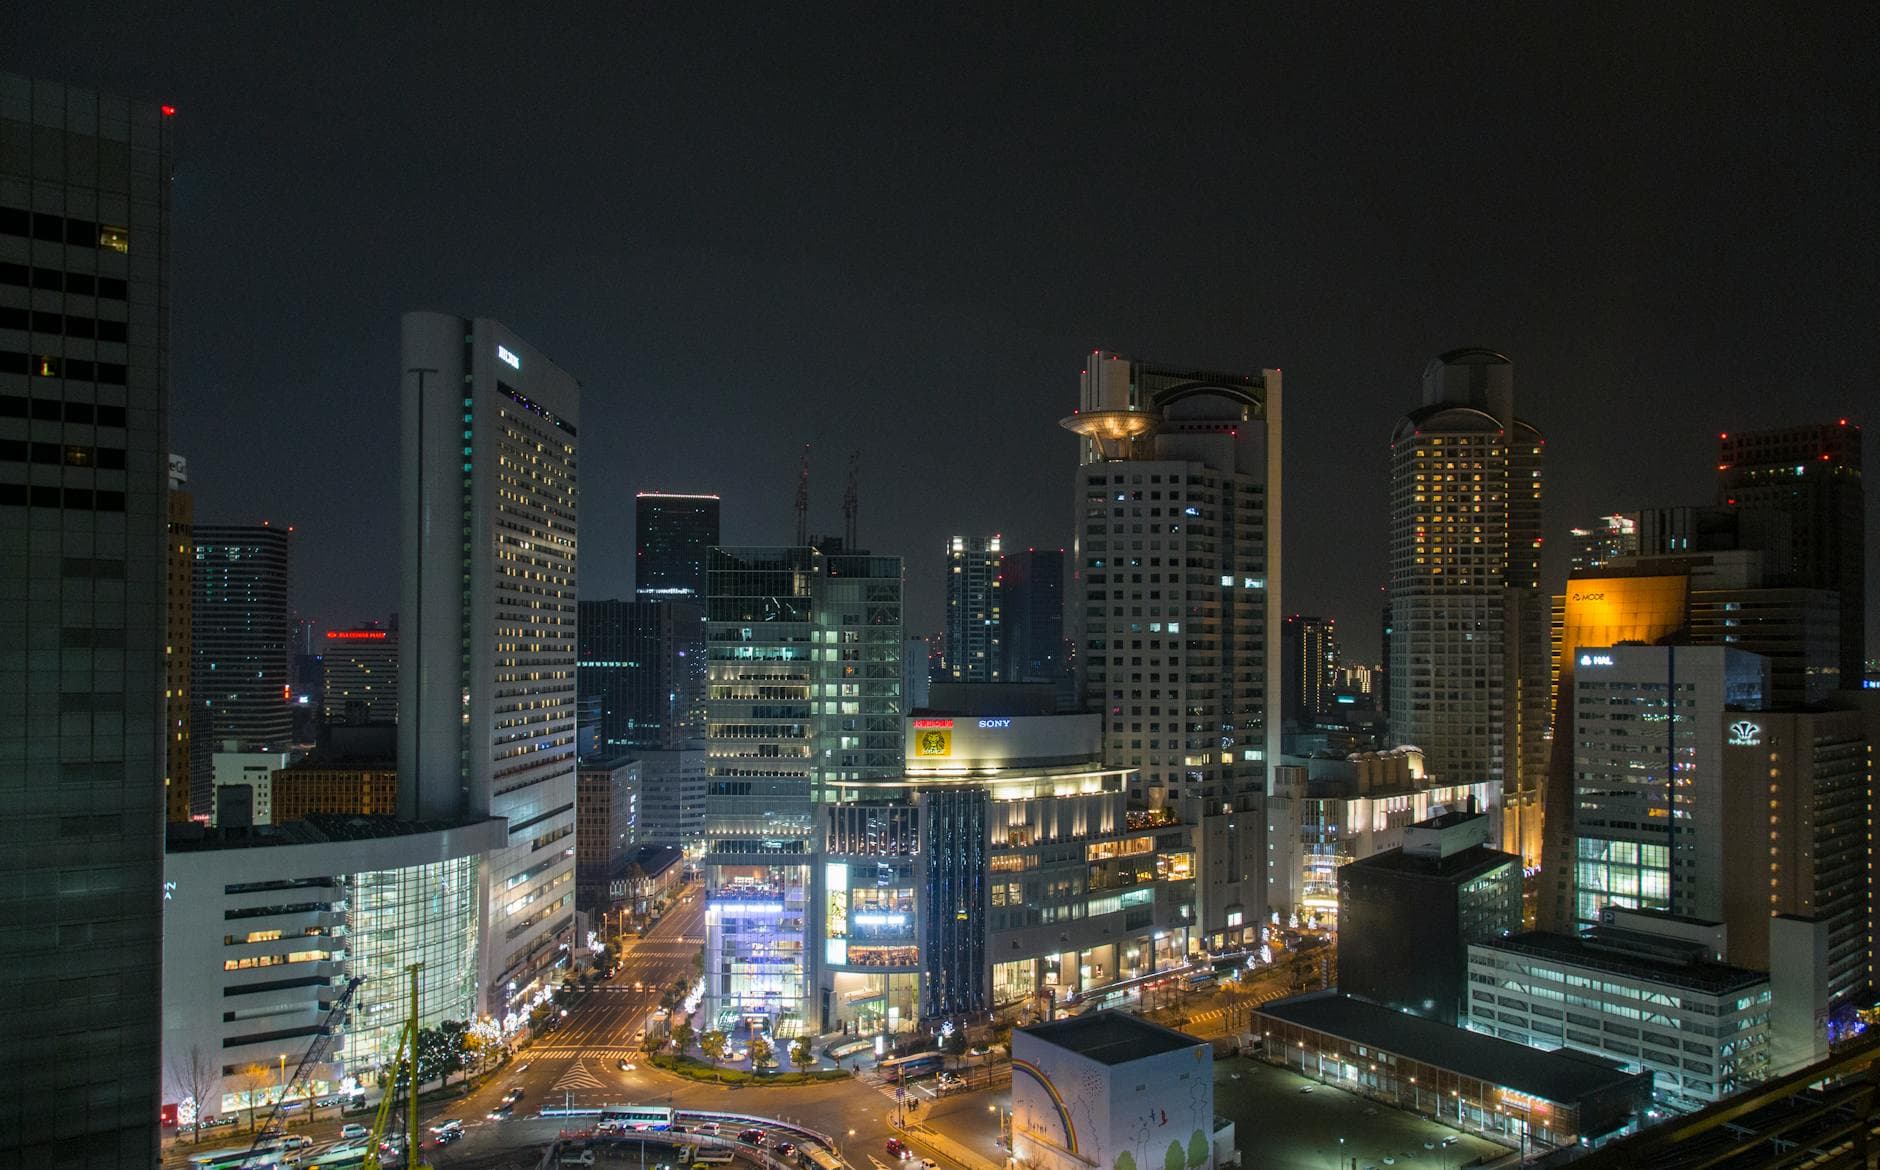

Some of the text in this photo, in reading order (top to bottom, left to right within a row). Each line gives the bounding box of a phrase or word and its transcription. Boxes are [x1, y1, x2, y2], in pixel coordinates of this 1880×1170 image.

[1581, 593, 1605, 601] MODE
[1593, 656, 1613, 665] HAL
[979, 720, 1010, 728] SONY
[1604, 912, 1614, 923] P
